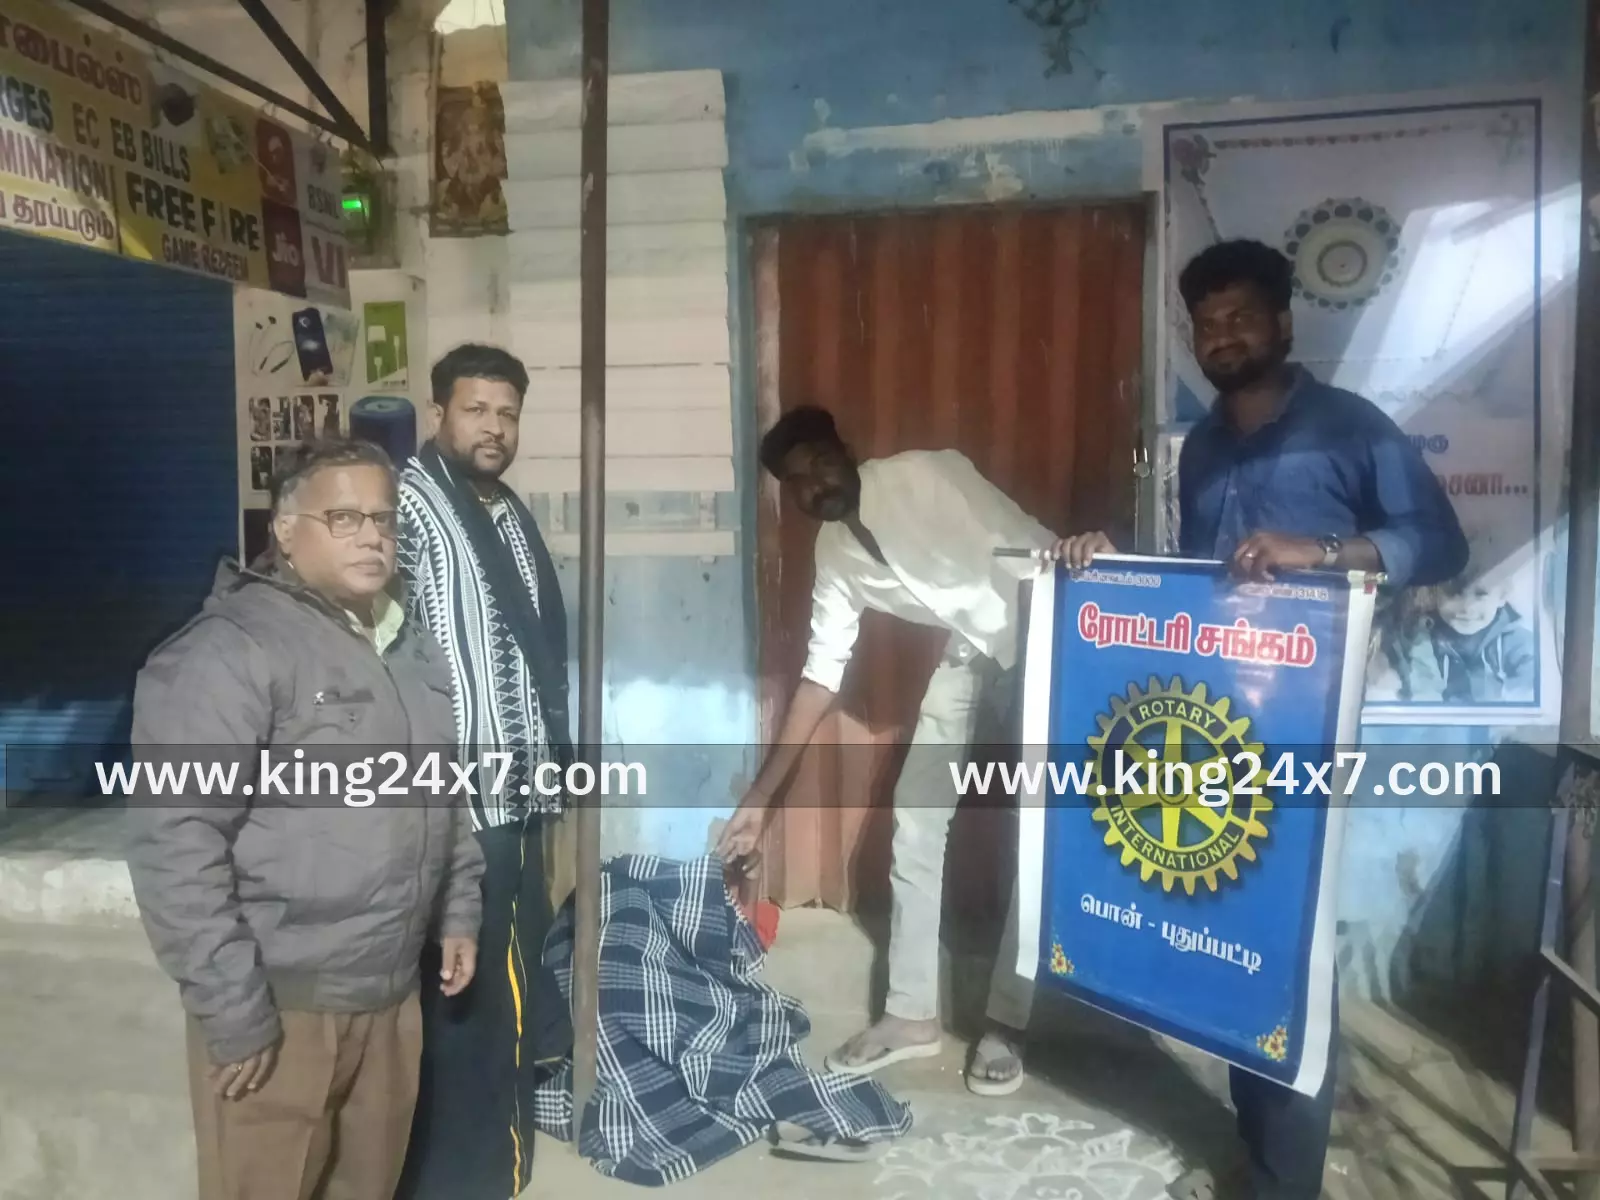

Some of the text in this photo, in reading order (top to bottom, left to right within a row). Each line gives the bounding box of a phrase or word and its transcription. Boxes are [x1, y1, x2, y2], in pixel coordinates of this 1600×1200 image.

[72, 101, 100, 151] EC
[110, 117, 137, 162] EB
[141, 130, 191, 182] BILLS
[13, 193, 114, 241] தரப்படும்
[125, 171, 261, 253] FREE FIRE
[1078, 601, 1317, 667] ரோட்டரி சங்கம்
[1139, 699, 1217, 729] ROTARY
[1110, 806, 1240, 870] INTERNATIONAL
[1080, 893, 1144, 930] பொன்
[1161, 920, 1263, 976] புதுப்பட்டி
